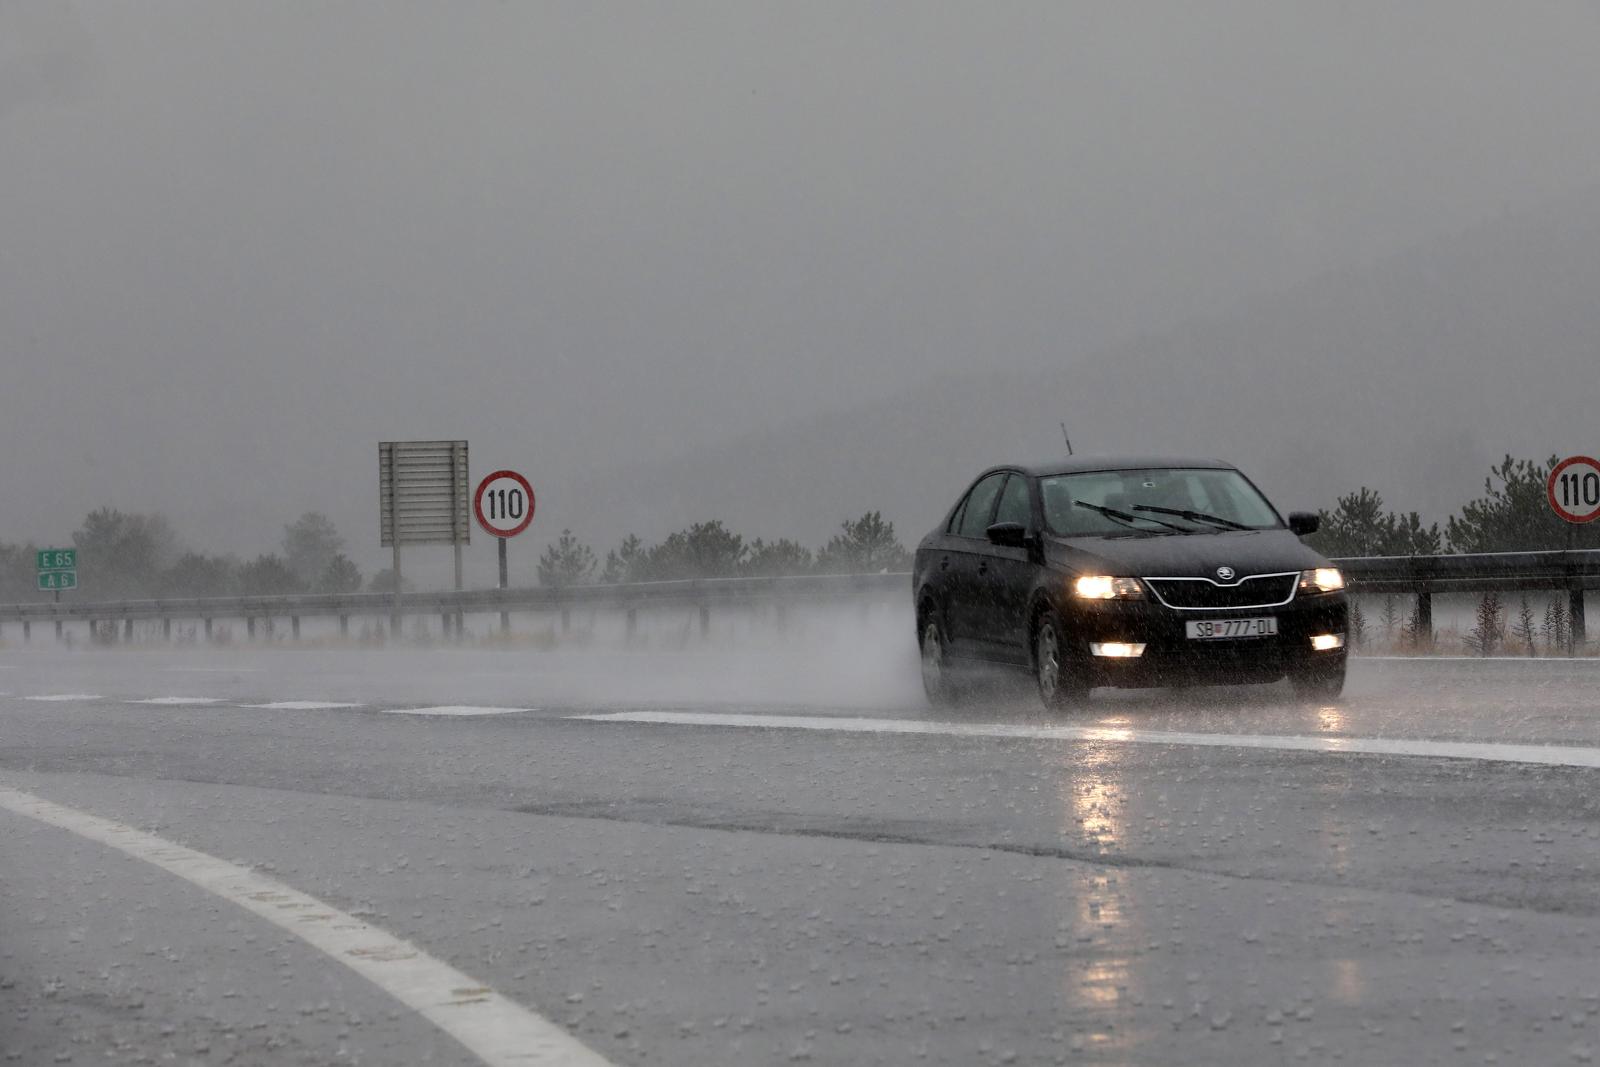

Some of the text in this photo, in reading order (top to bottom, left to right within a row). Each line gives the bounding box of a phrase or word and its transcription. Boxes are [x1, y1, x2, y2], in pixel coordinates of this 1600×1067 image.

[1561, 473, 1600, 506] 110
[488, 489, 522, 519] 110
[43, 552, 72, 567] E 65
[48, 574, 69, 588] A 6
[1196, 620, 1274, 637] SB 777-DL
